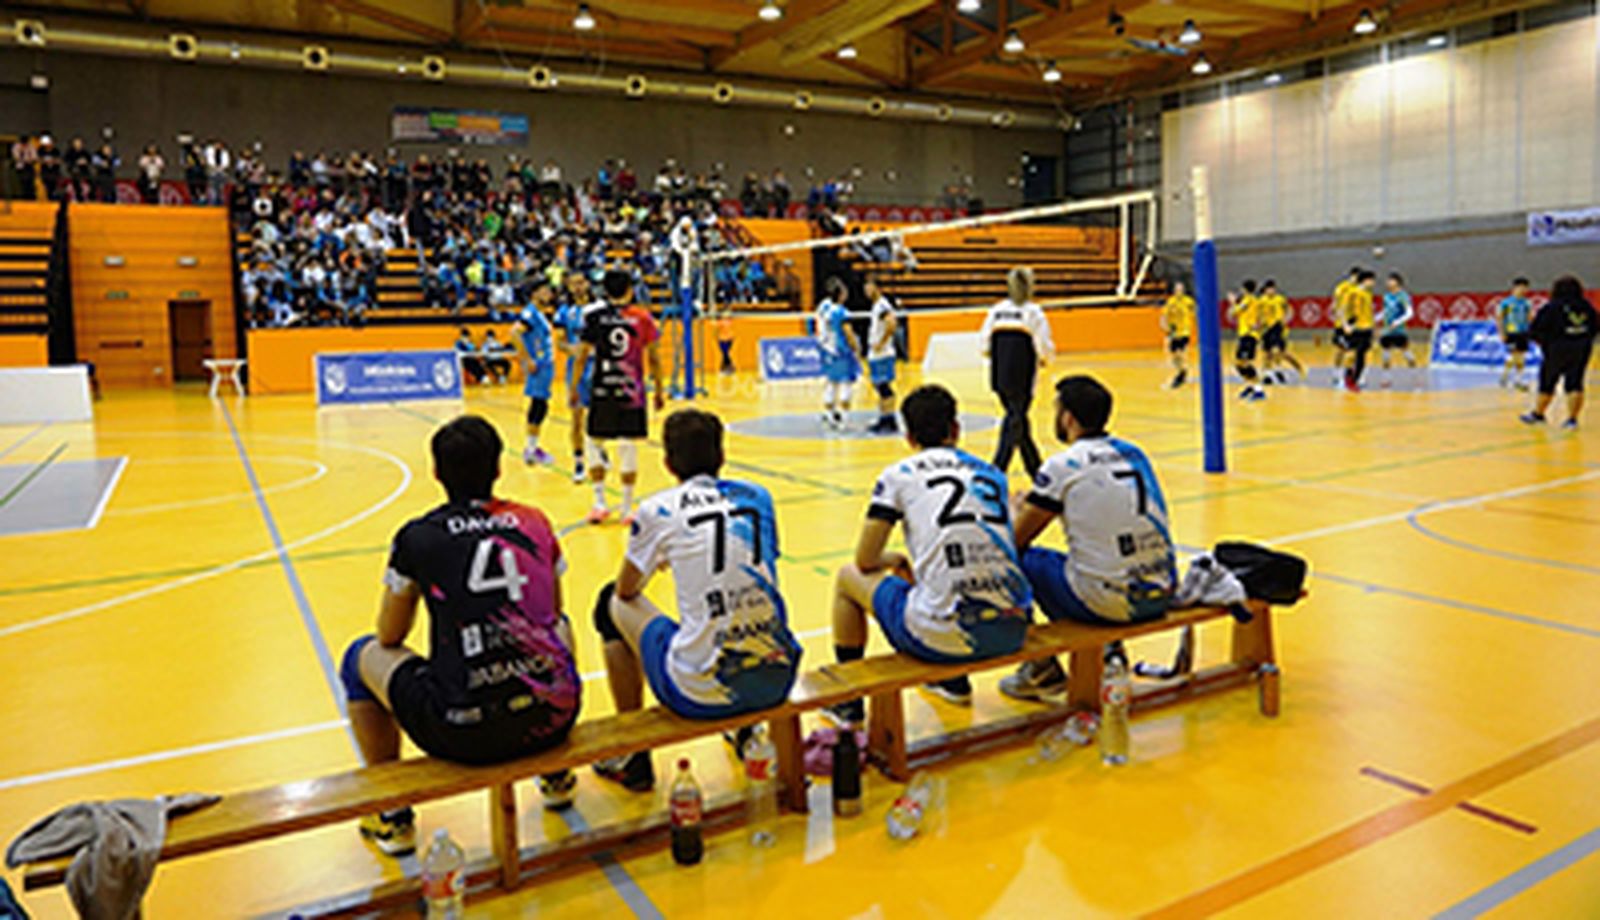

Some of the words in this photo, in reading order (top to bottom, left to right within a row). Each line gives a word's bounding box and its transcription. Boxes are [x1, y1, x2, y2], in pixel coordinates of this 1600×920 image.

[608, 326, 630, 357] 9
[926, 474, 1009, 527] 23
[1111, 470, 1146, 516] 7
[447, 511, 519, 535] DAVID
[687, 510, 762, 575] 77
[467, 539, 529, 601] 4
